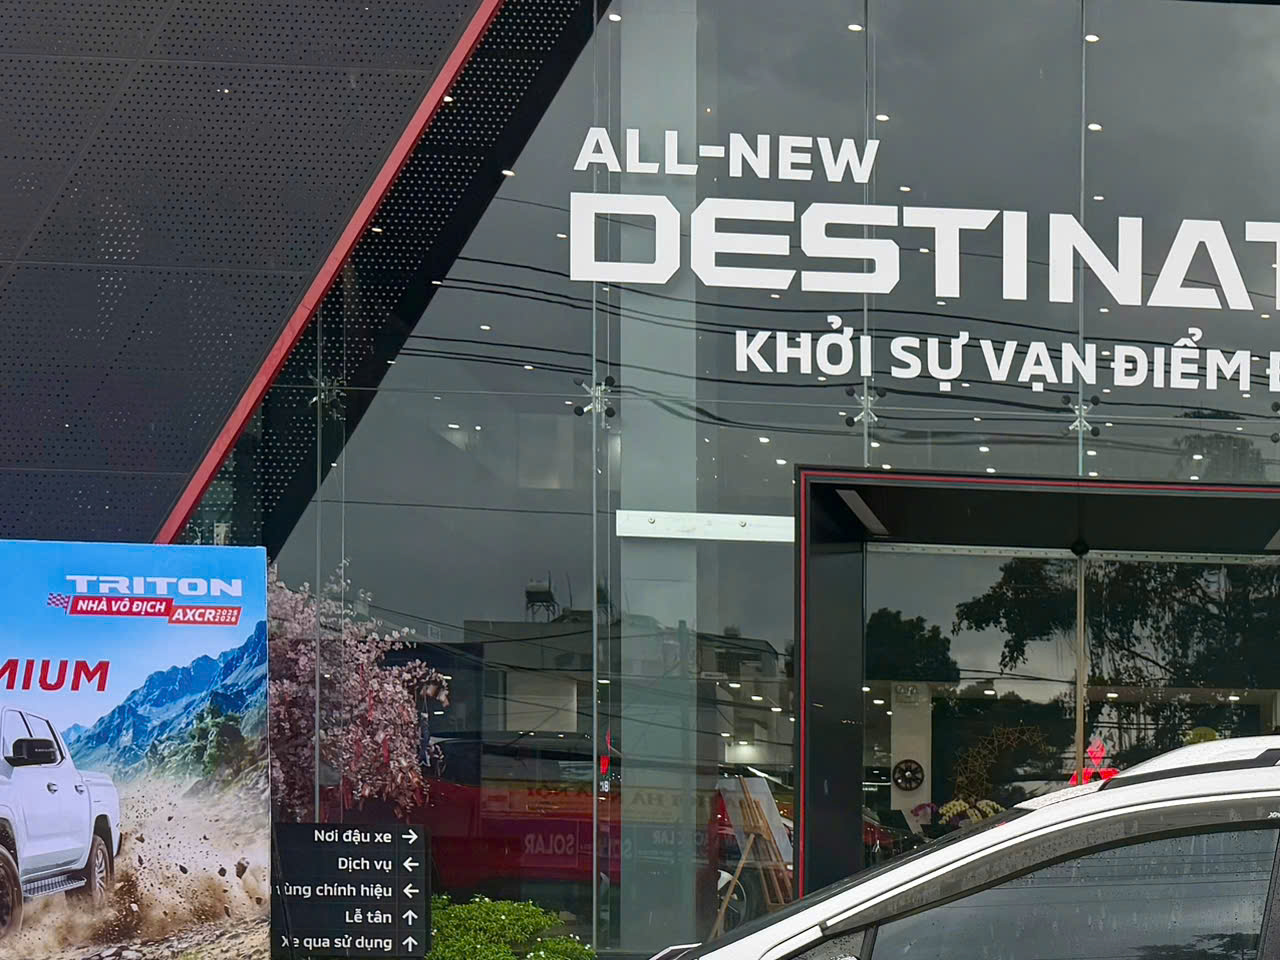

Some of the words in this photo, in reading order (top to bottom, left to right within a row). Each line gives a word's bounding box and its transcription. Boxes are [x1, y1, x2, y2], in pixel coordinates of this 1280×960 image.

[573, 127, 881, 184] ALL-NEW
[734, 314, 872, 377] KHỞI
[891, 332, 967, 392] SỰ
[982, 342, 1098, 390] VẠN
[1110, 326, 1252, 392] ĐIỂM
[66, 575, 242, 596] TRITON
[77, 598, 108, 612] NHÀ
[111, 598, 131, 612] VÔ
[132, 601, 166, 615] ĐỊCH
[172, 608, 215, 622] AXCR
[314, 829, 339, 842] Nơi
[342, 829, 370, 845] đậu
[374, 832, 392, 843] xe
[337, 857, 370, 872] Dịch
[374, 860, 392, 873] vụ
[315, 883, 356, 897] chính
[360, 884, 392, 900] hiệu
[345, 908, 363, 924] Lễ
[366, 911, 392, 924] tân
[303, 938, 330, 950] qua
[333, 935, 352, 948] sử
[355, 936, 392, 952] dụng
